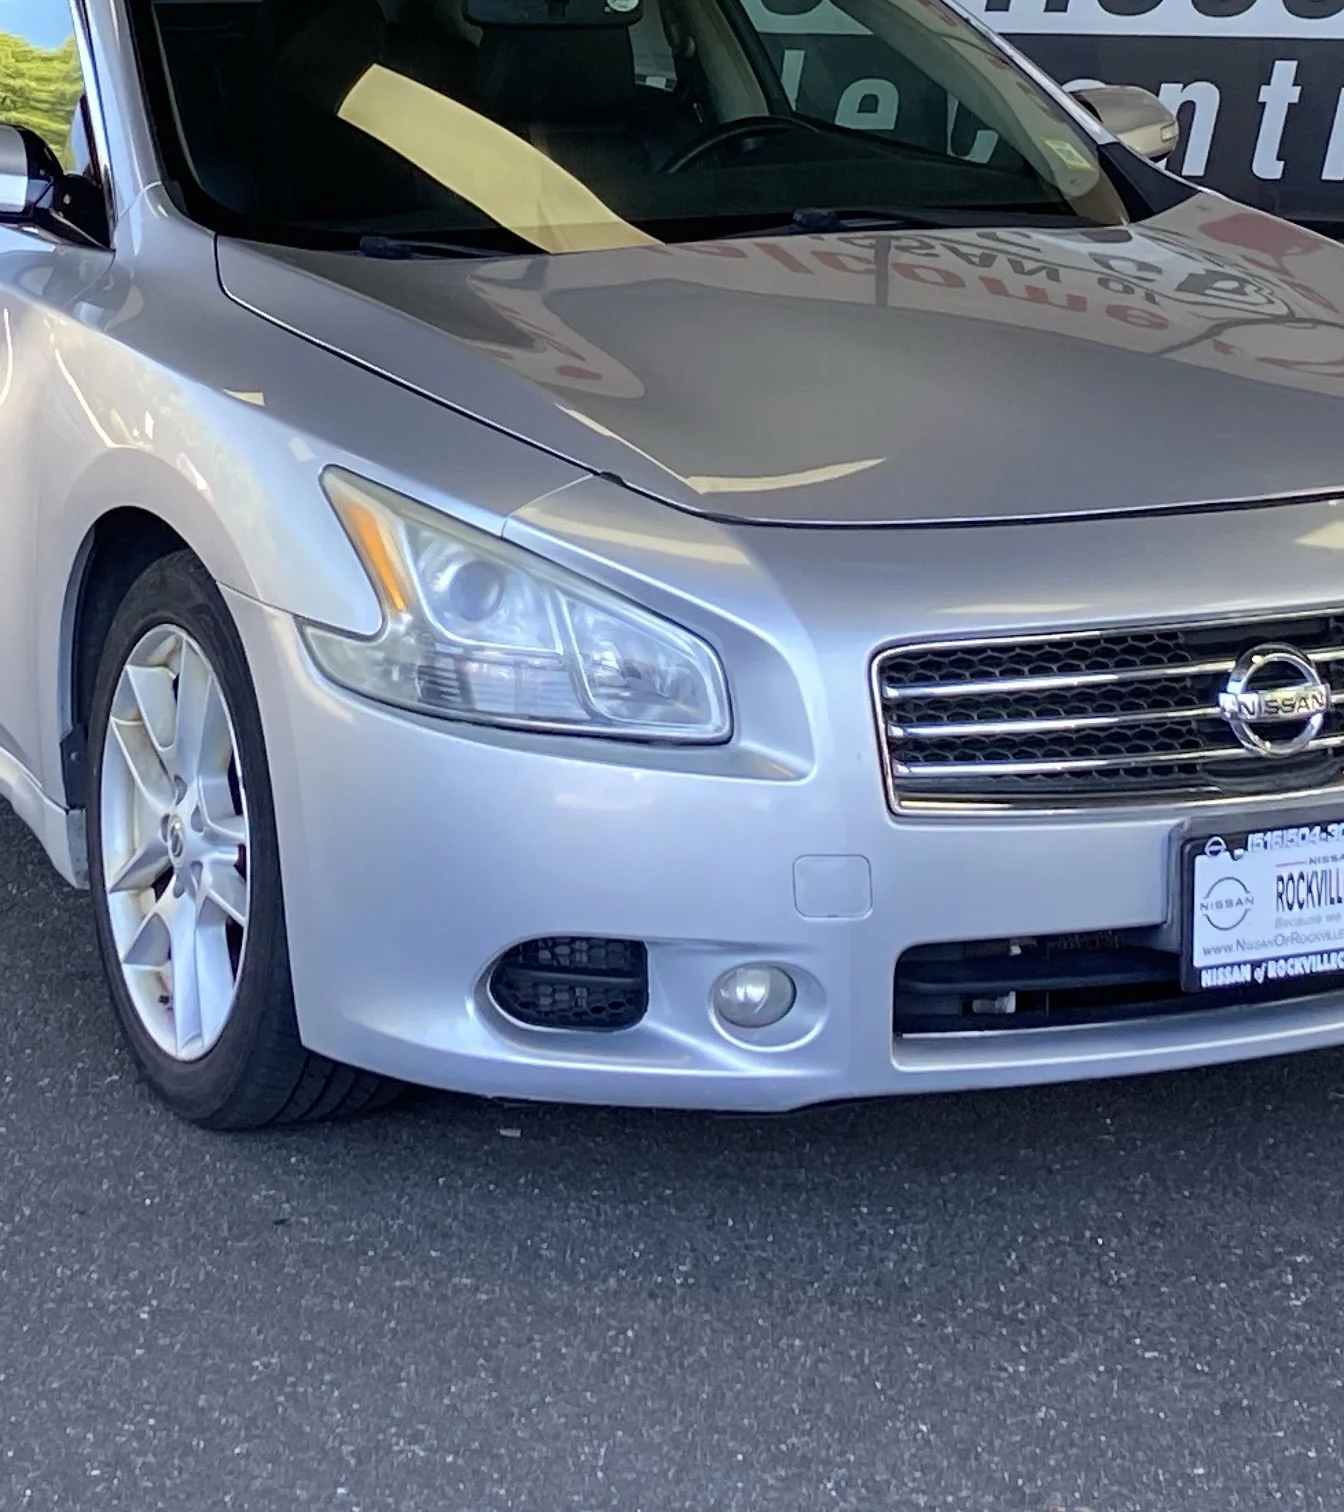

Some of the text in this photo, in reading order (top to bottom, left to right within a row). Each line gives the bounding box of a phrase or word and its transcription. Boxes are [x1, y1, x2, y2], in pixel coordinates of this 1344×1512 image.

[1237, 690, 1325, 717] NISSAN
[1199, 895, 1254, 911] NISSAN
[1201, 964, 1251, 988] NISSAN
